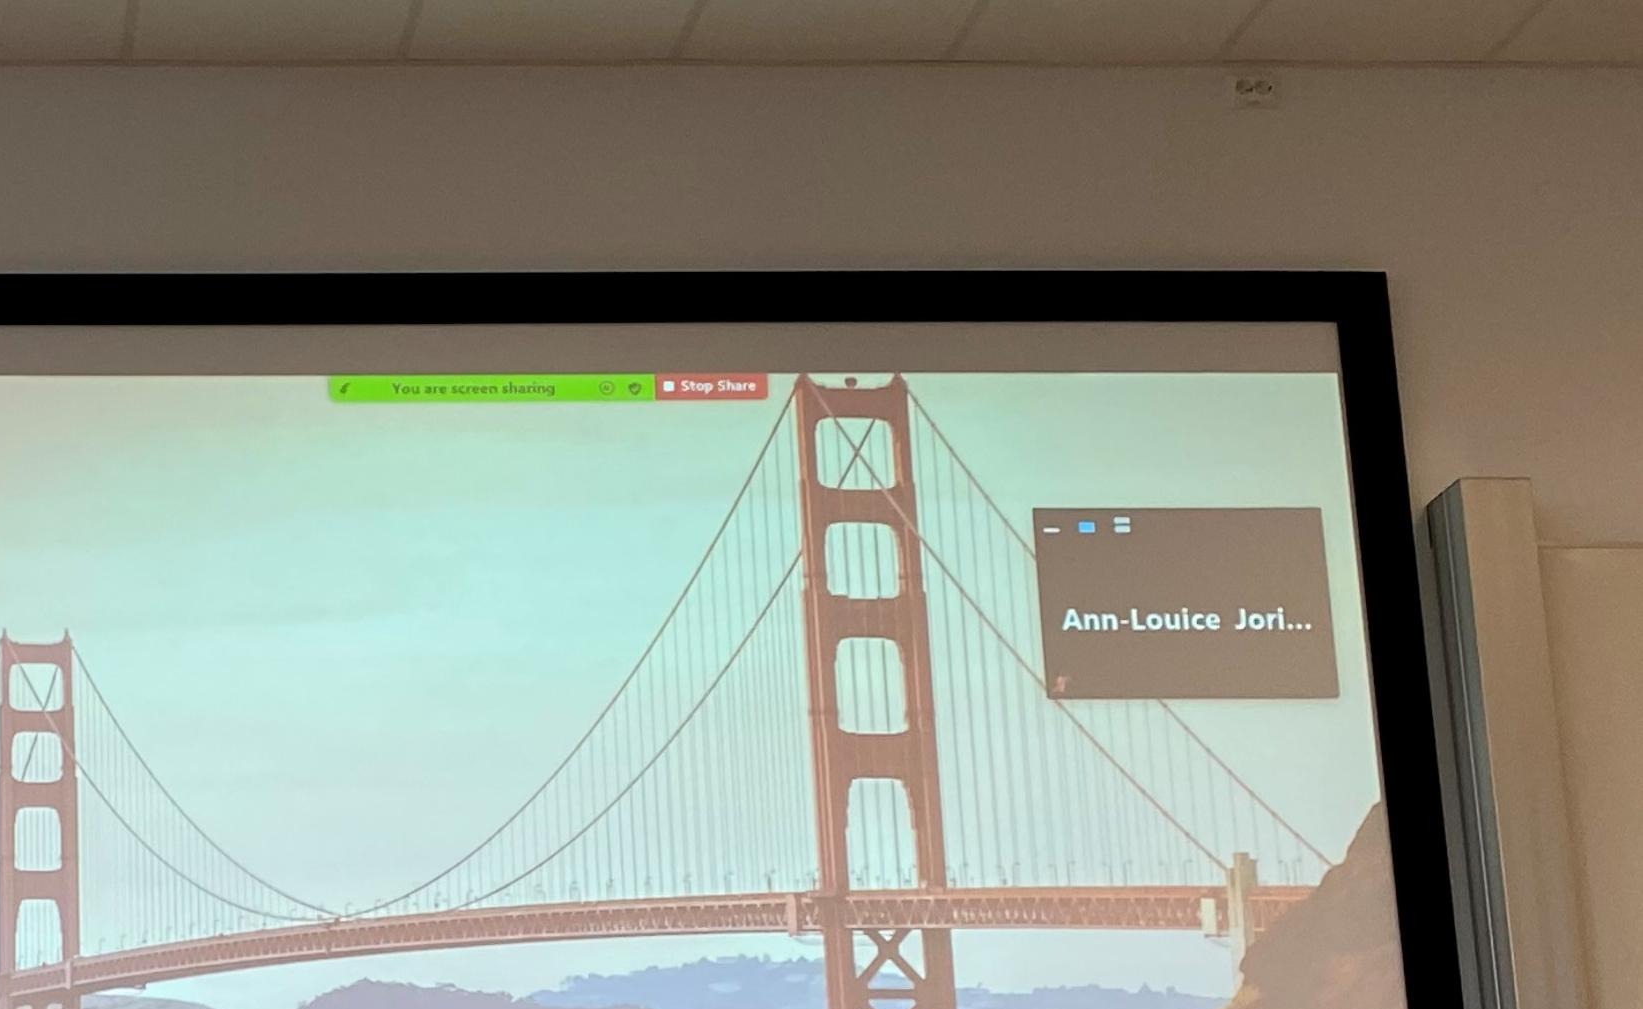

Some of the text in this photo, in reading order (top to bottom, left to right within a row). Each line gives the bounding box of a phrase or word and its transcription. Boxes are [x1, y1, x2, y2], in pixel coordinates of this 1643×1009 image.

[391, 382, 556, 396] You are screen sharing
[680, 380, 756, 394] Stop Share
[1062, 606, 1312, 631] Ann-Louice Jori...
